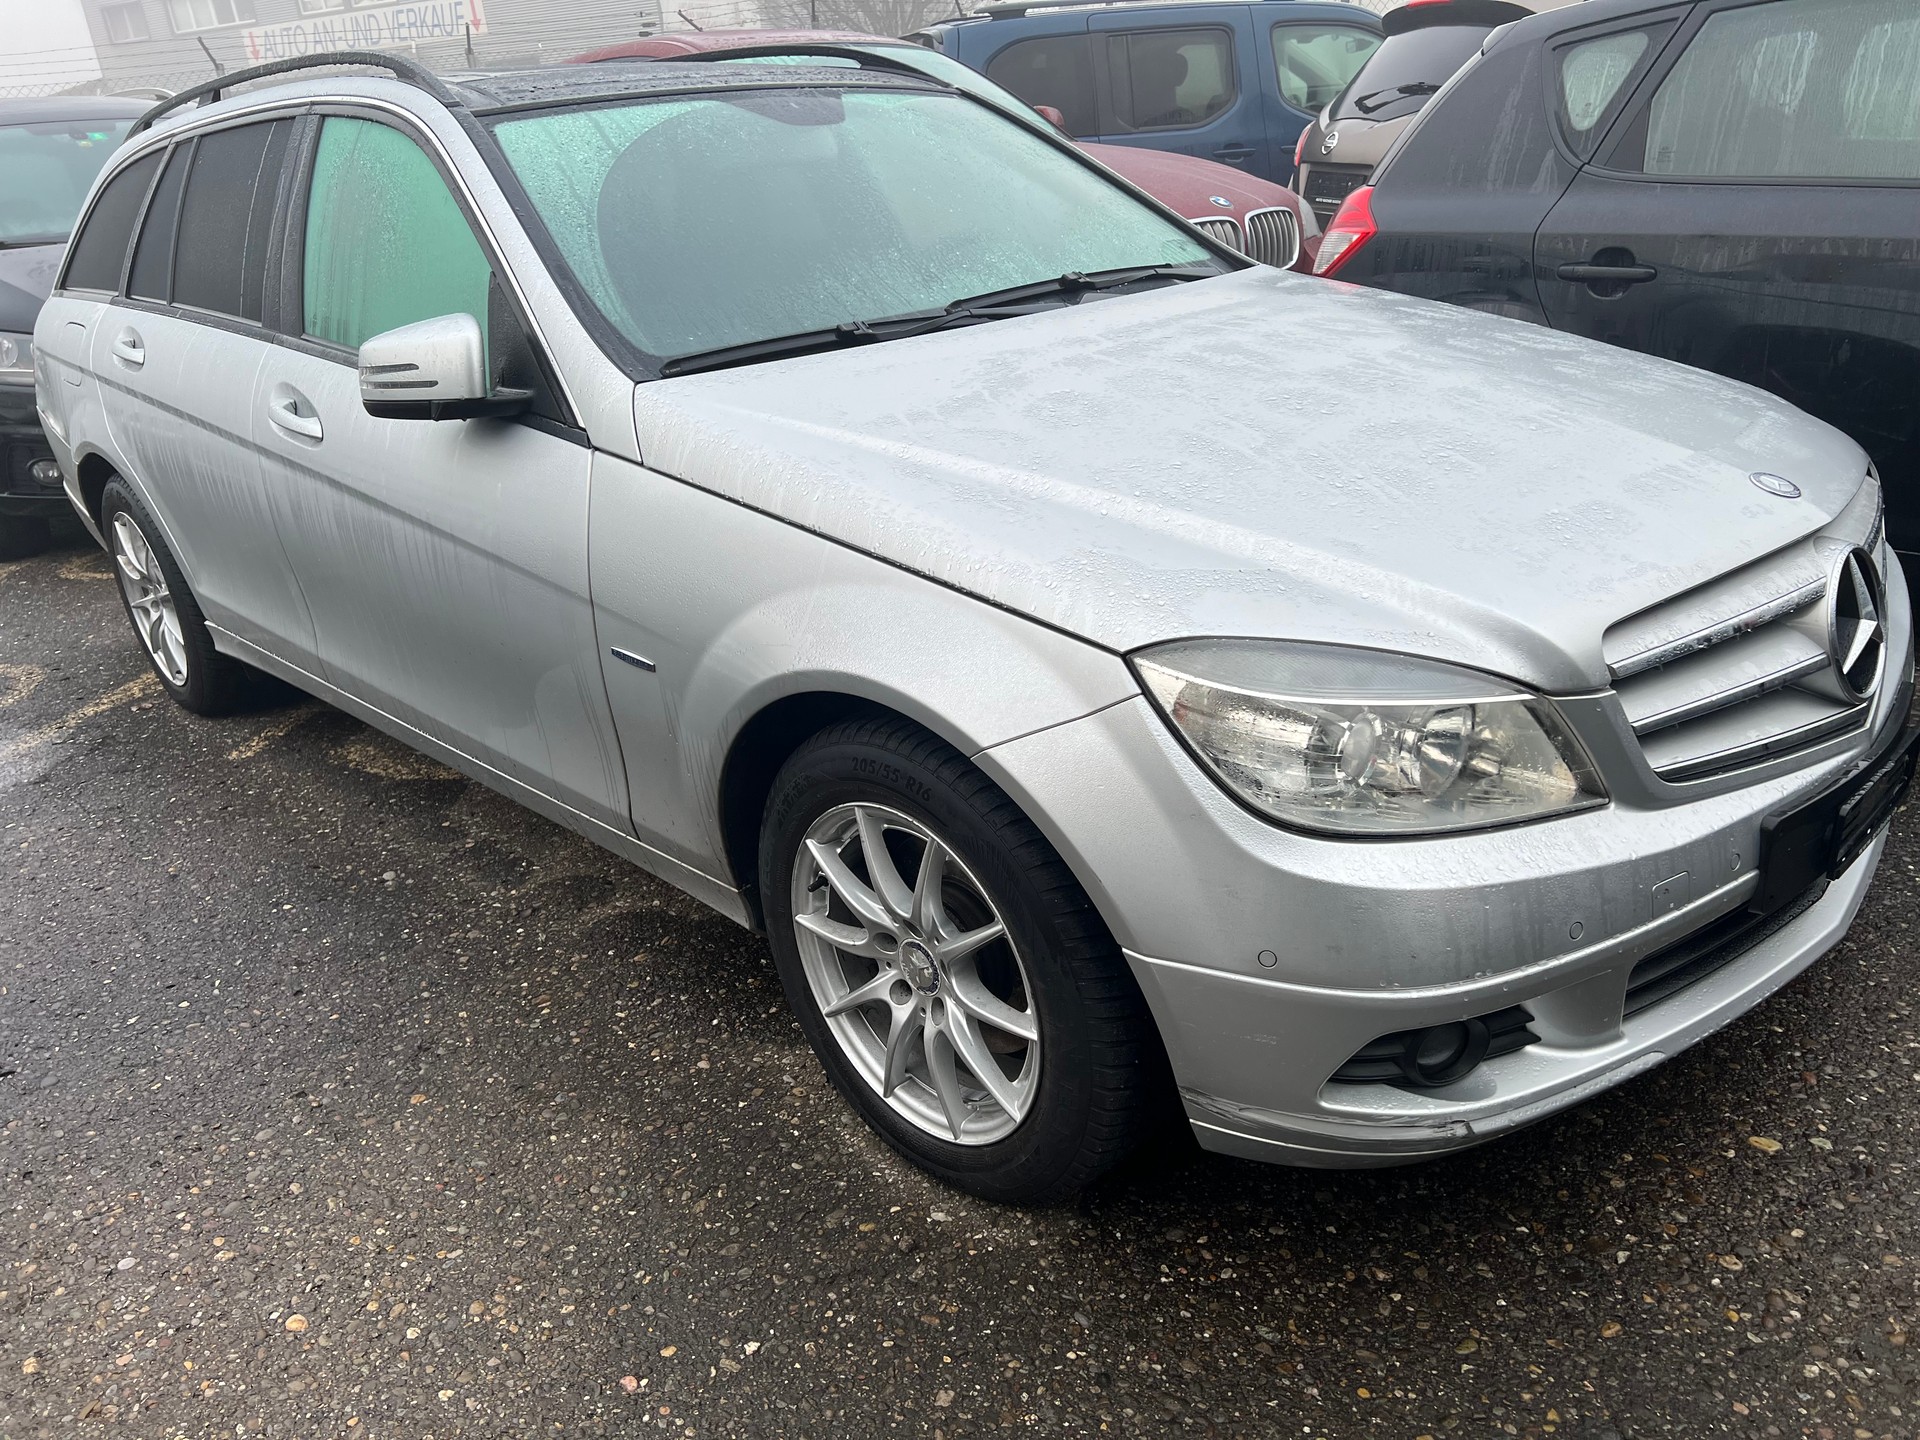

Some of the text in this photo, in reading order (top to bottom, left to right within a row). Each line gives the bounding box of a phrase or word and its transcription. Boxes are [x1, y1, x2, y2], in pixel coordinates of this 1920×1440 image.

[264, 25, 306, 59] AUTO
[385, 2, 465, 43] VERKAUF
[851, 756, 932, 802] 205/55 R16
